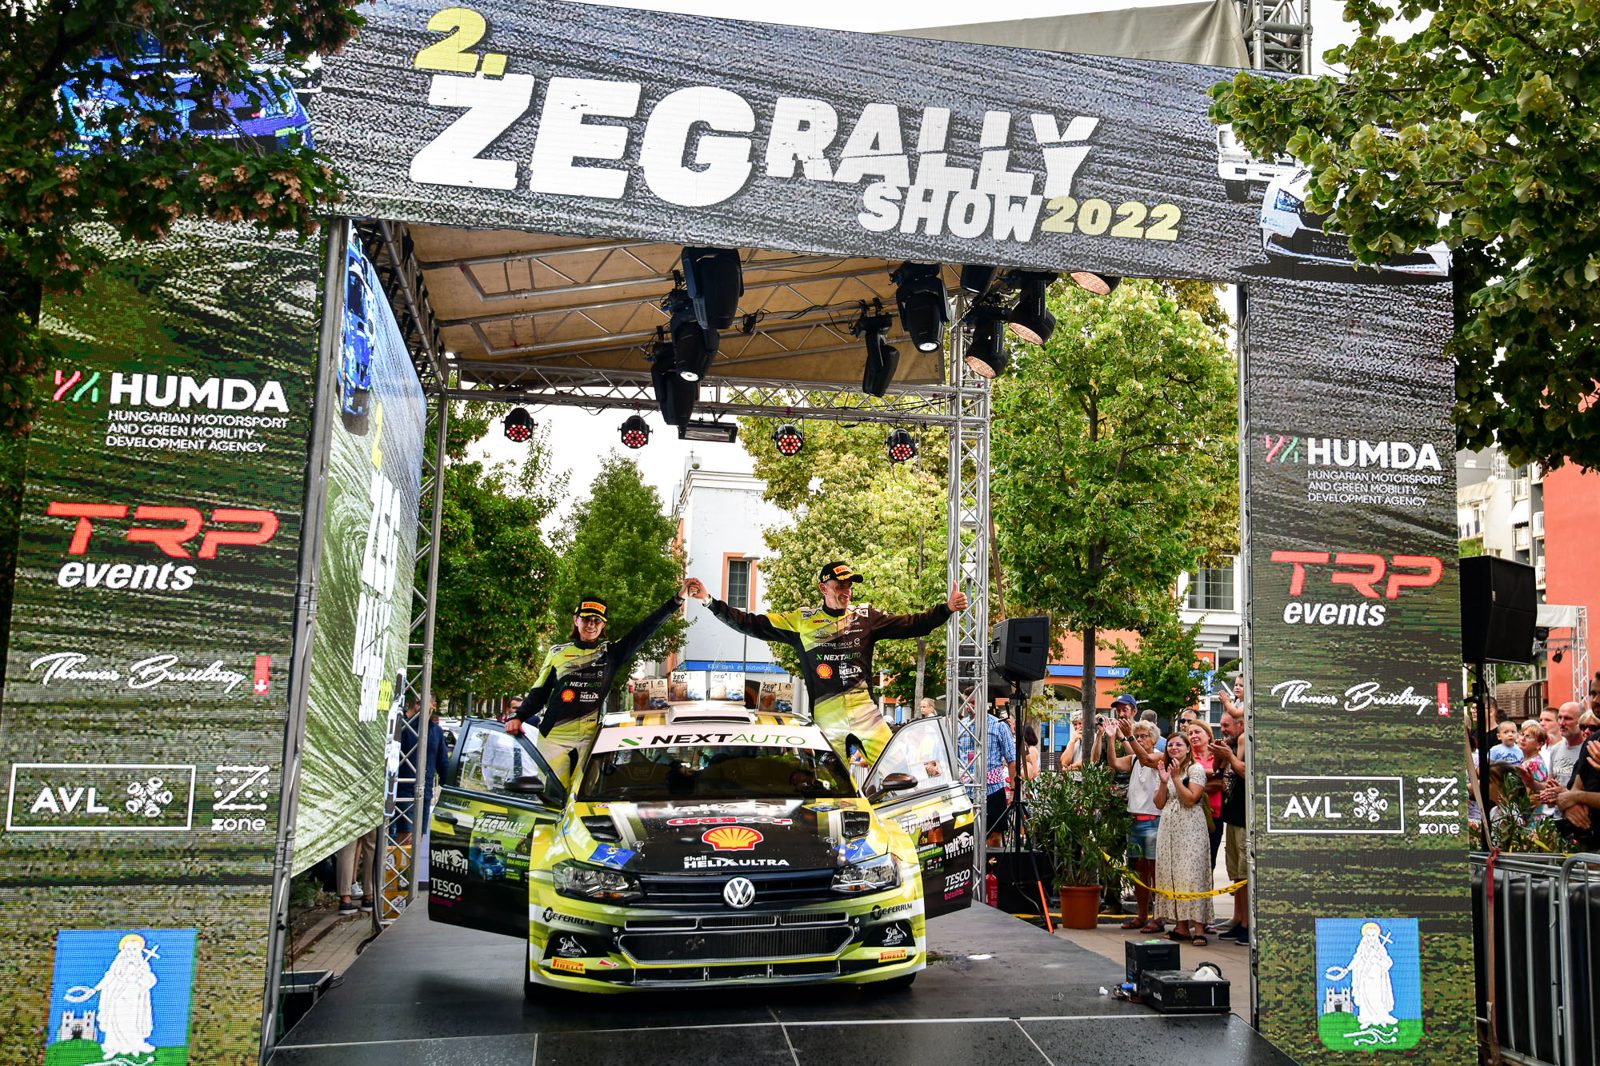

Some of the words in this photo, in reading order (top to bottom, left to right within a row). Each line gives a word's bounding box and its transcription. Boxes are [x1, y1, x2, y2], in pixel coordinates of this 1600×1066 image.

[414, 8, 508, 76] 2.
[858, 182, 1043, 243] SHOW
[1041, 196, 1182, 241] 2022
[109, 372, 290, 413] HUMDA
[108, 410, 191, 424] HUNGARIAN
[193, 413, 290, 428] MOTORSPORT
[107, 423, 139, 435] AND
[142, 424, 188, 437] GREEN
[191, 426, 254, 440] MOBILITY
[106, 436, 205, 450] DEVELOPMENT
[208, 439, 267, 453] AGENCY
[1307, 438, 1442, 471] HUMDA
[1307, 470, 1369, 483] HUNGARIAN
[1370, 473, 1443, 485] MOTORSPORT
[1308, 481, 1331, 491] AND
[1333, 482, 1369, 493] GREEN
[1370, 483, 1417, 495] MOBILITY
[1307, 492, 1382, 504] DEVELOPMENT
[1384, 496, 1427, 506] AGENCY
[47, 501, 279, 559] TRP
[57, 561, 197, 590] events
[1270, 550, 1443, 600] TRP
[1283, 601, 1386, 626] events
[30, 787, 109, 814] AVL
[1283, 796, 1342, 818] AVL
[211, 818, 266, 832] zone
[1418, 823, 1460, 835] zone
[431, 861, 469, 875] SECURITY
[430, 877, 462, 896] TESCO
[945, 869, 971, 887] TESCO
